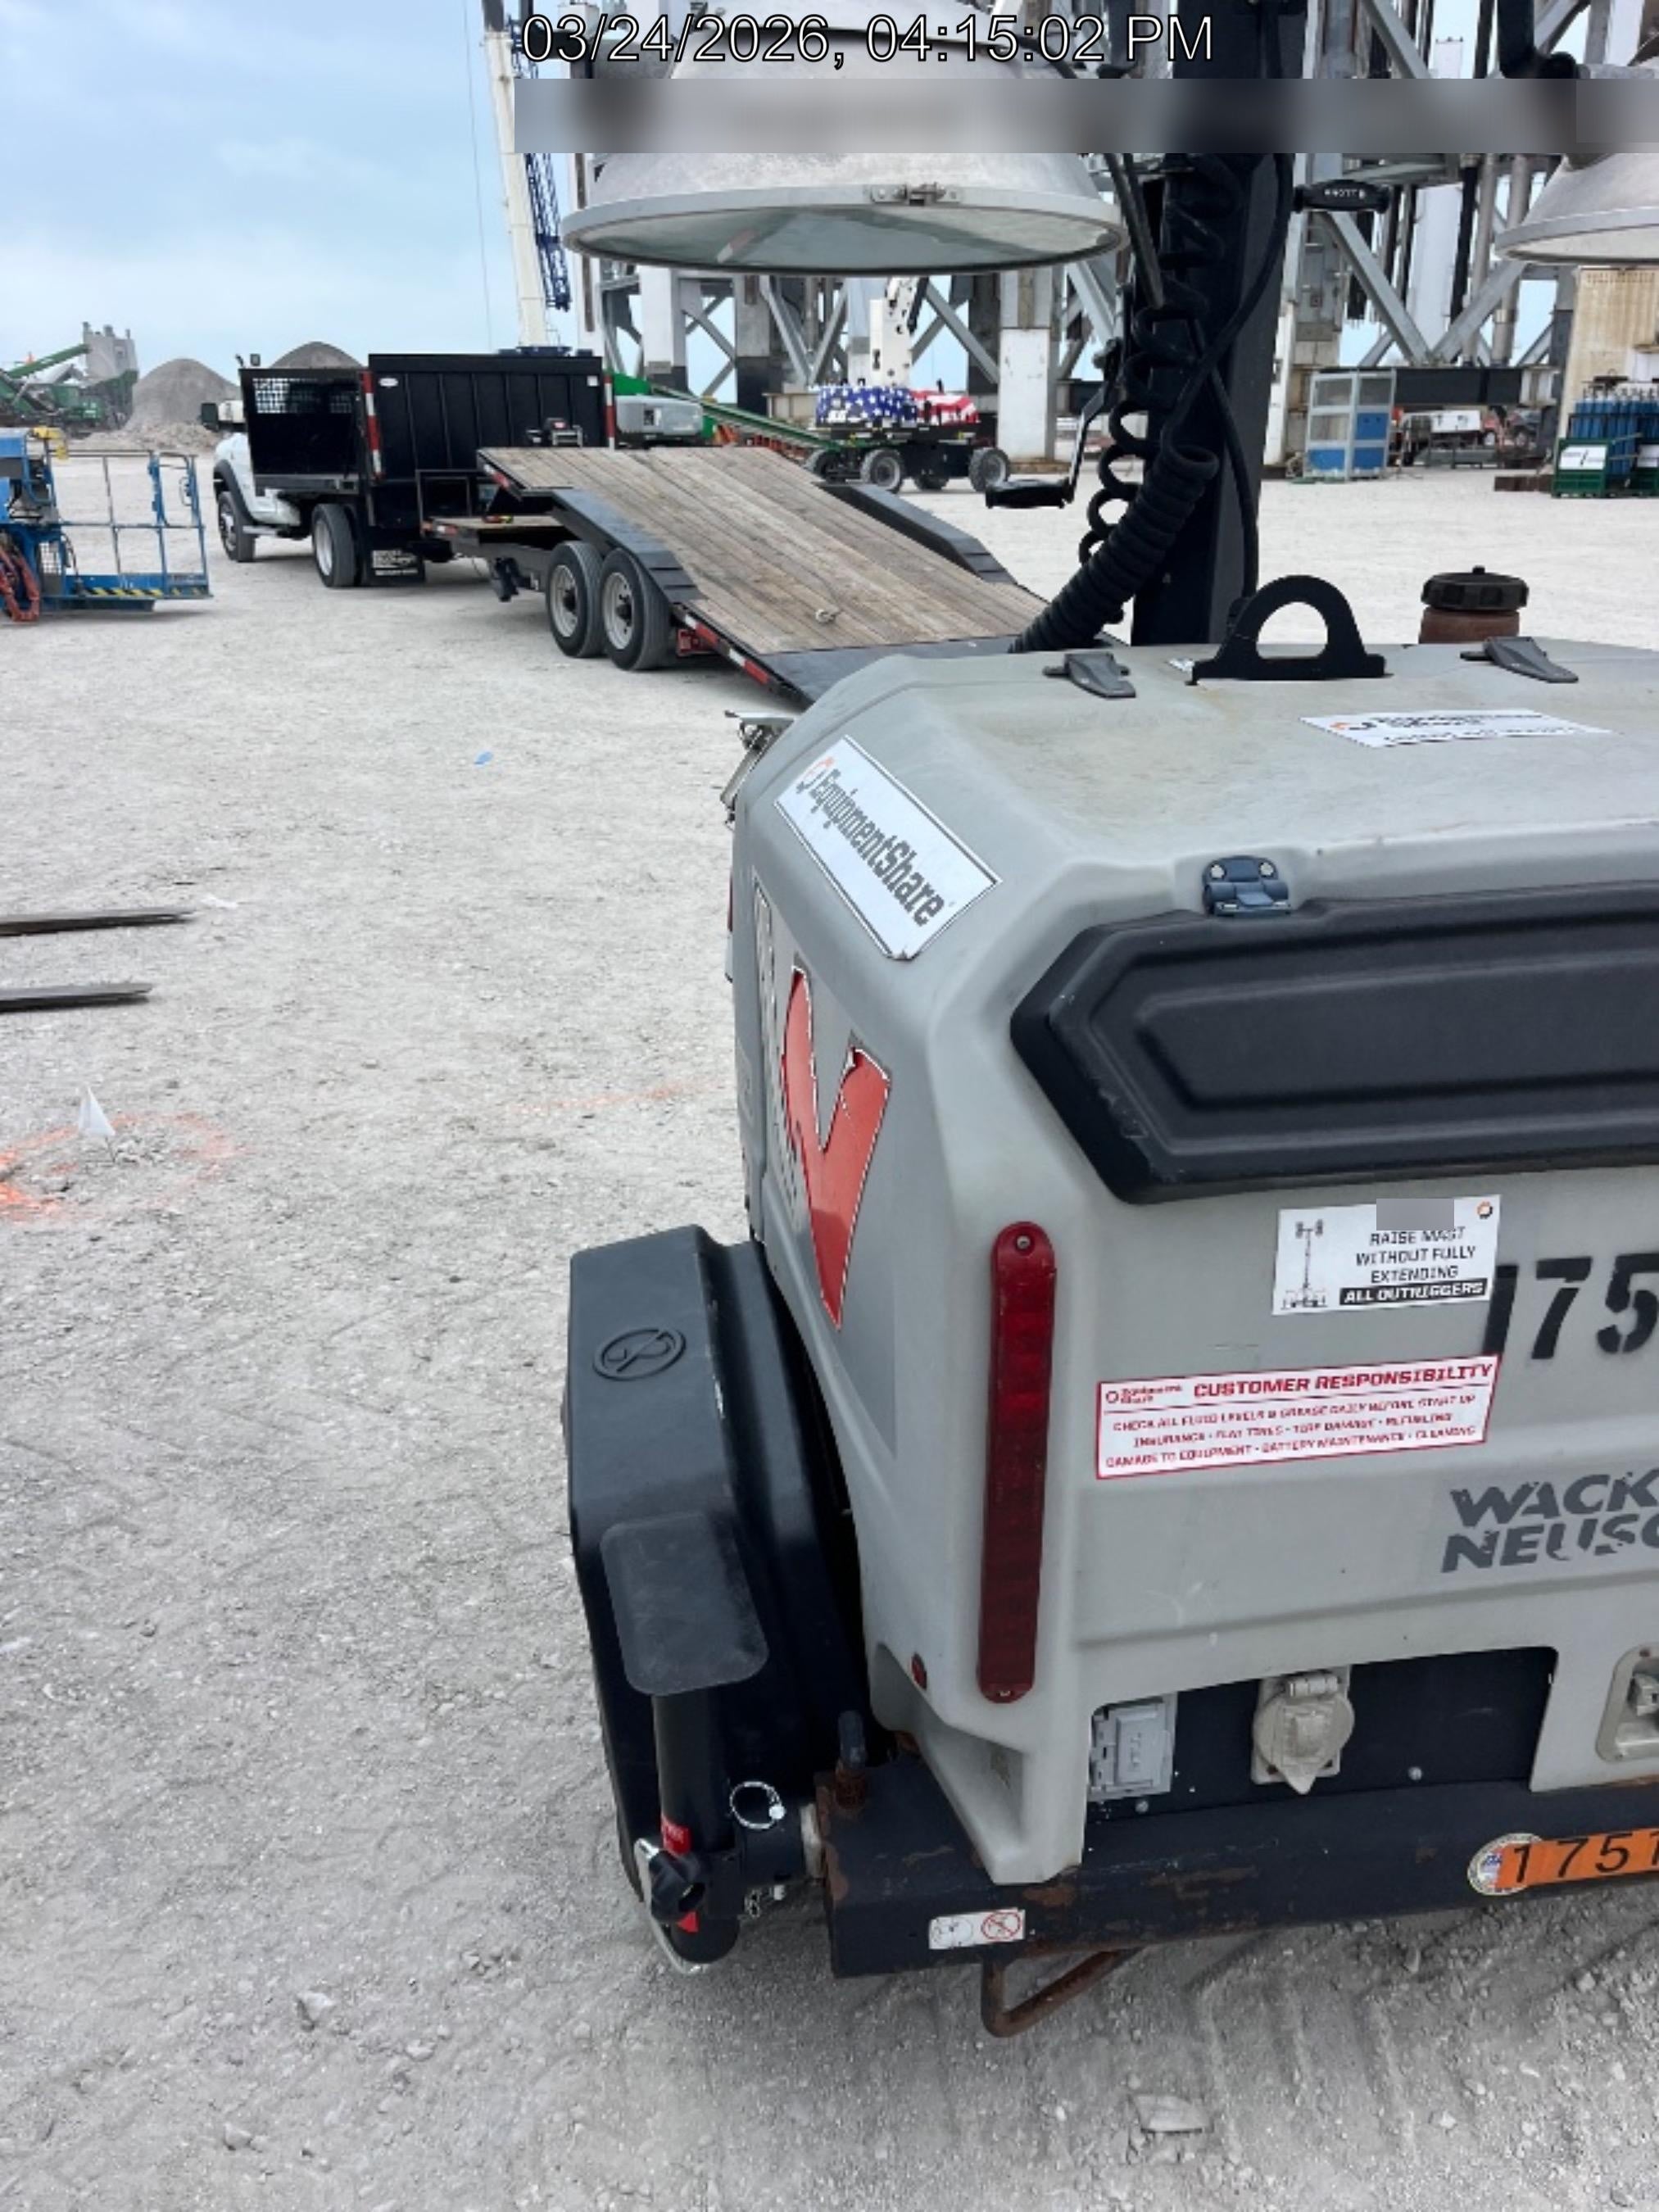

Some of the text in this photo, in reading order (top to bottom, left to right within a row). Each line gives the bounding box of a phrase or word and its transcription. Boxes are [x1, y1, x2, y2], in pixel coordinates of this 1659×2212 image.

[1370, 1231, 1416, 1245] RAISE
[1356, 1245, 1476, 1266] WITHOUT FULLY
[1371, 1265, 1458, 1284] EXTENDING
[1344, 1282, 1484, 1303] ALL OUTRIGGERS
[1194, 1364, 1493, 1398] CUSTOMER RESPONSIBILITY
